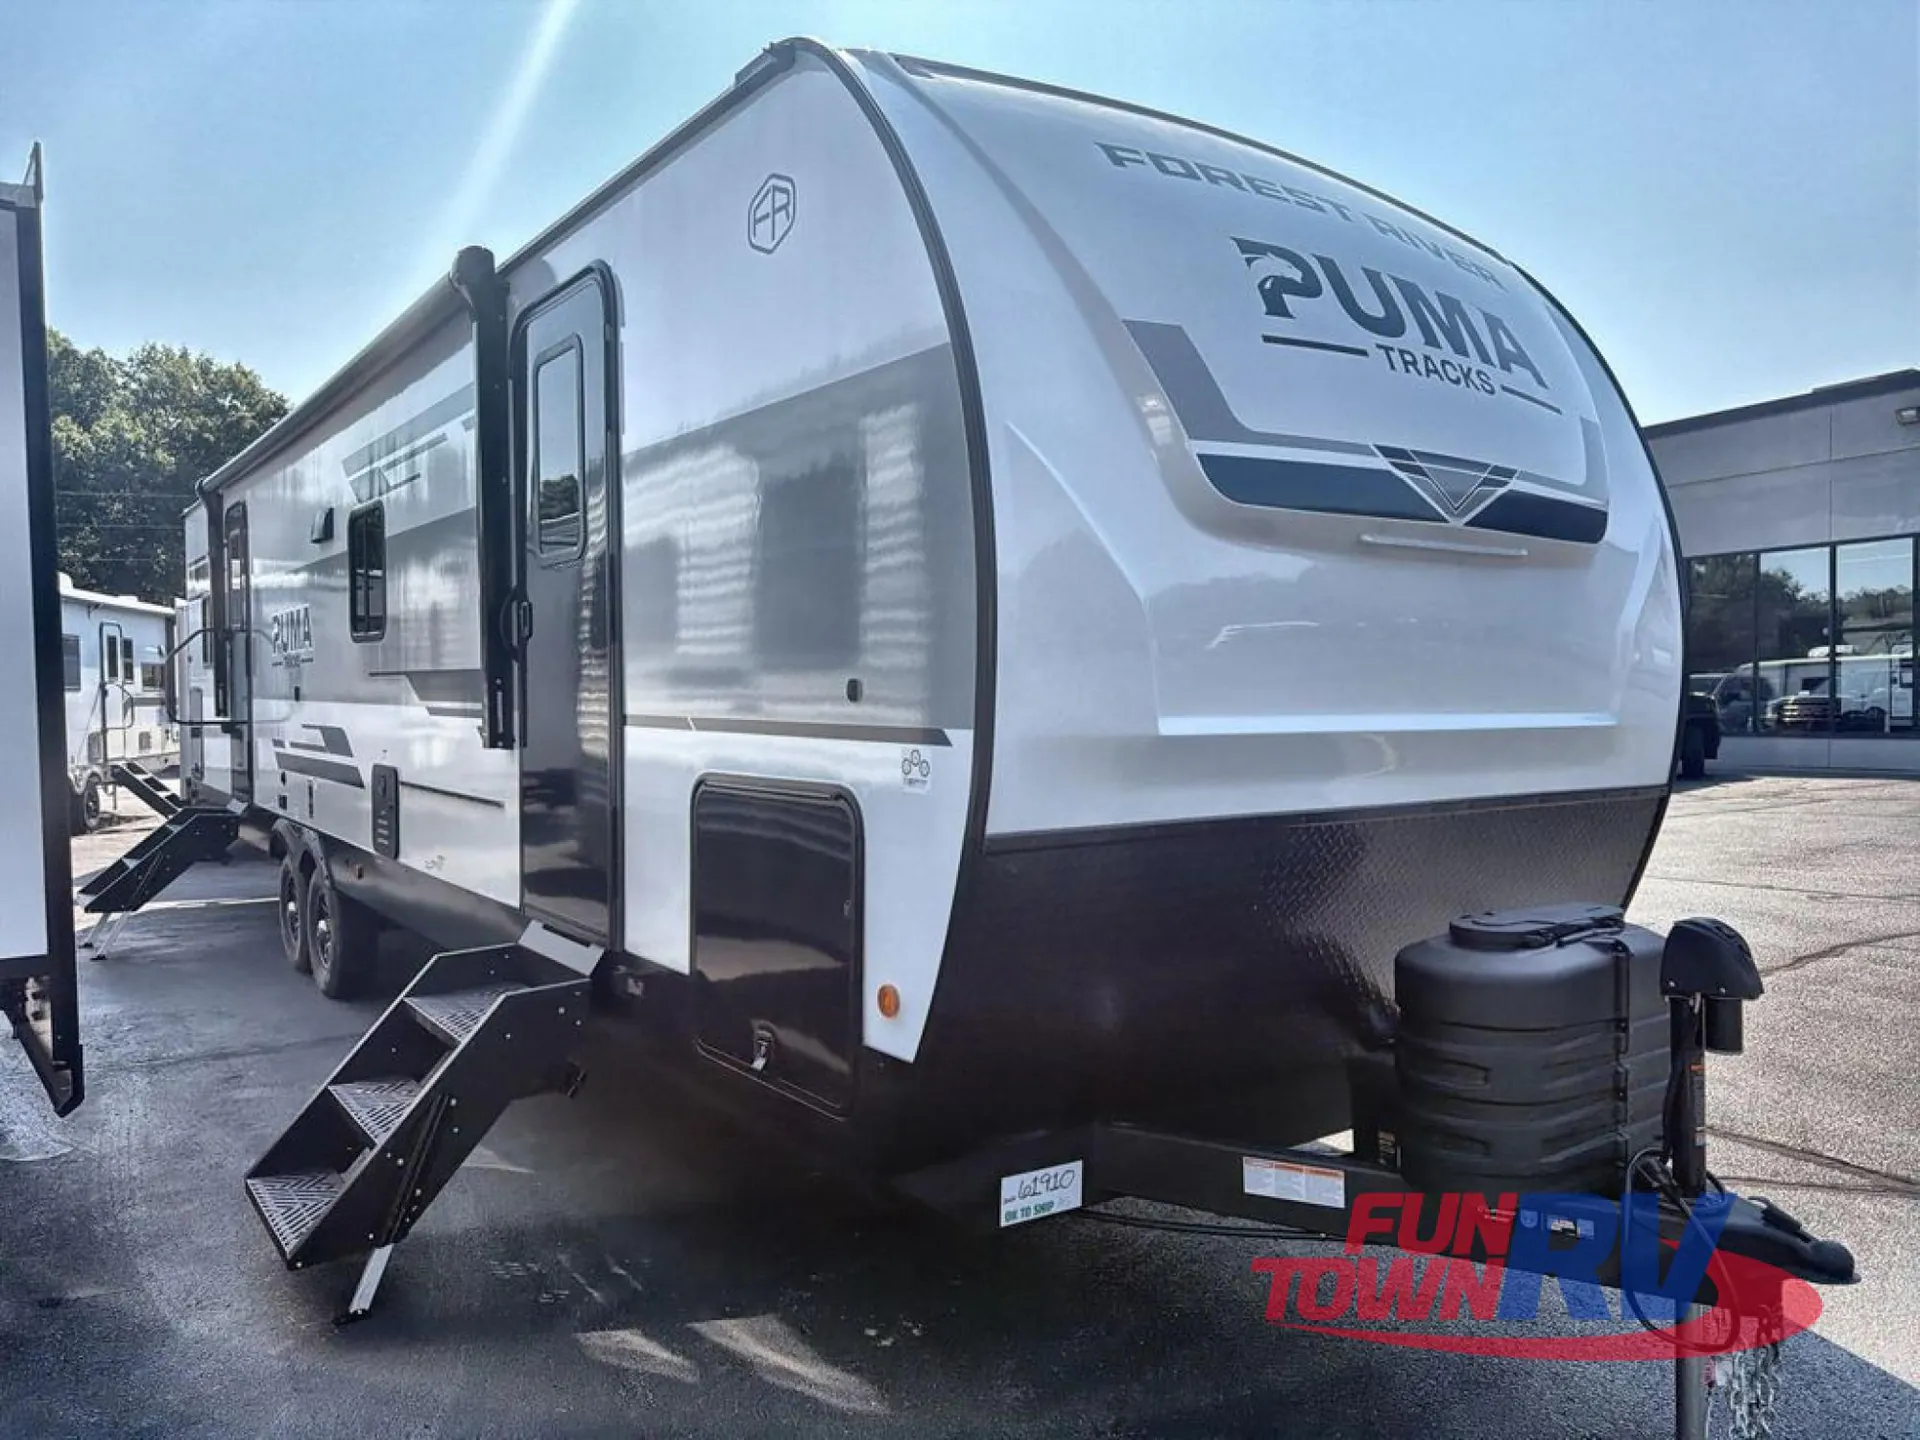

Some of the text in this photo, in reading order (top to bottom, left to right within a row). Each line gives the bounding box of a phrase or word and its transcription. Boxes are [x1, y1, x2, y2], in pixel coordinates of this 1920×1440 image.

[1094, 141, 1509, 292] FOREST RIVER
[1229, 235, 1549, 389] PUMA
[1375, 343, 1496, 396] TRACKS
[272, 606, 313, 653] PUMA
